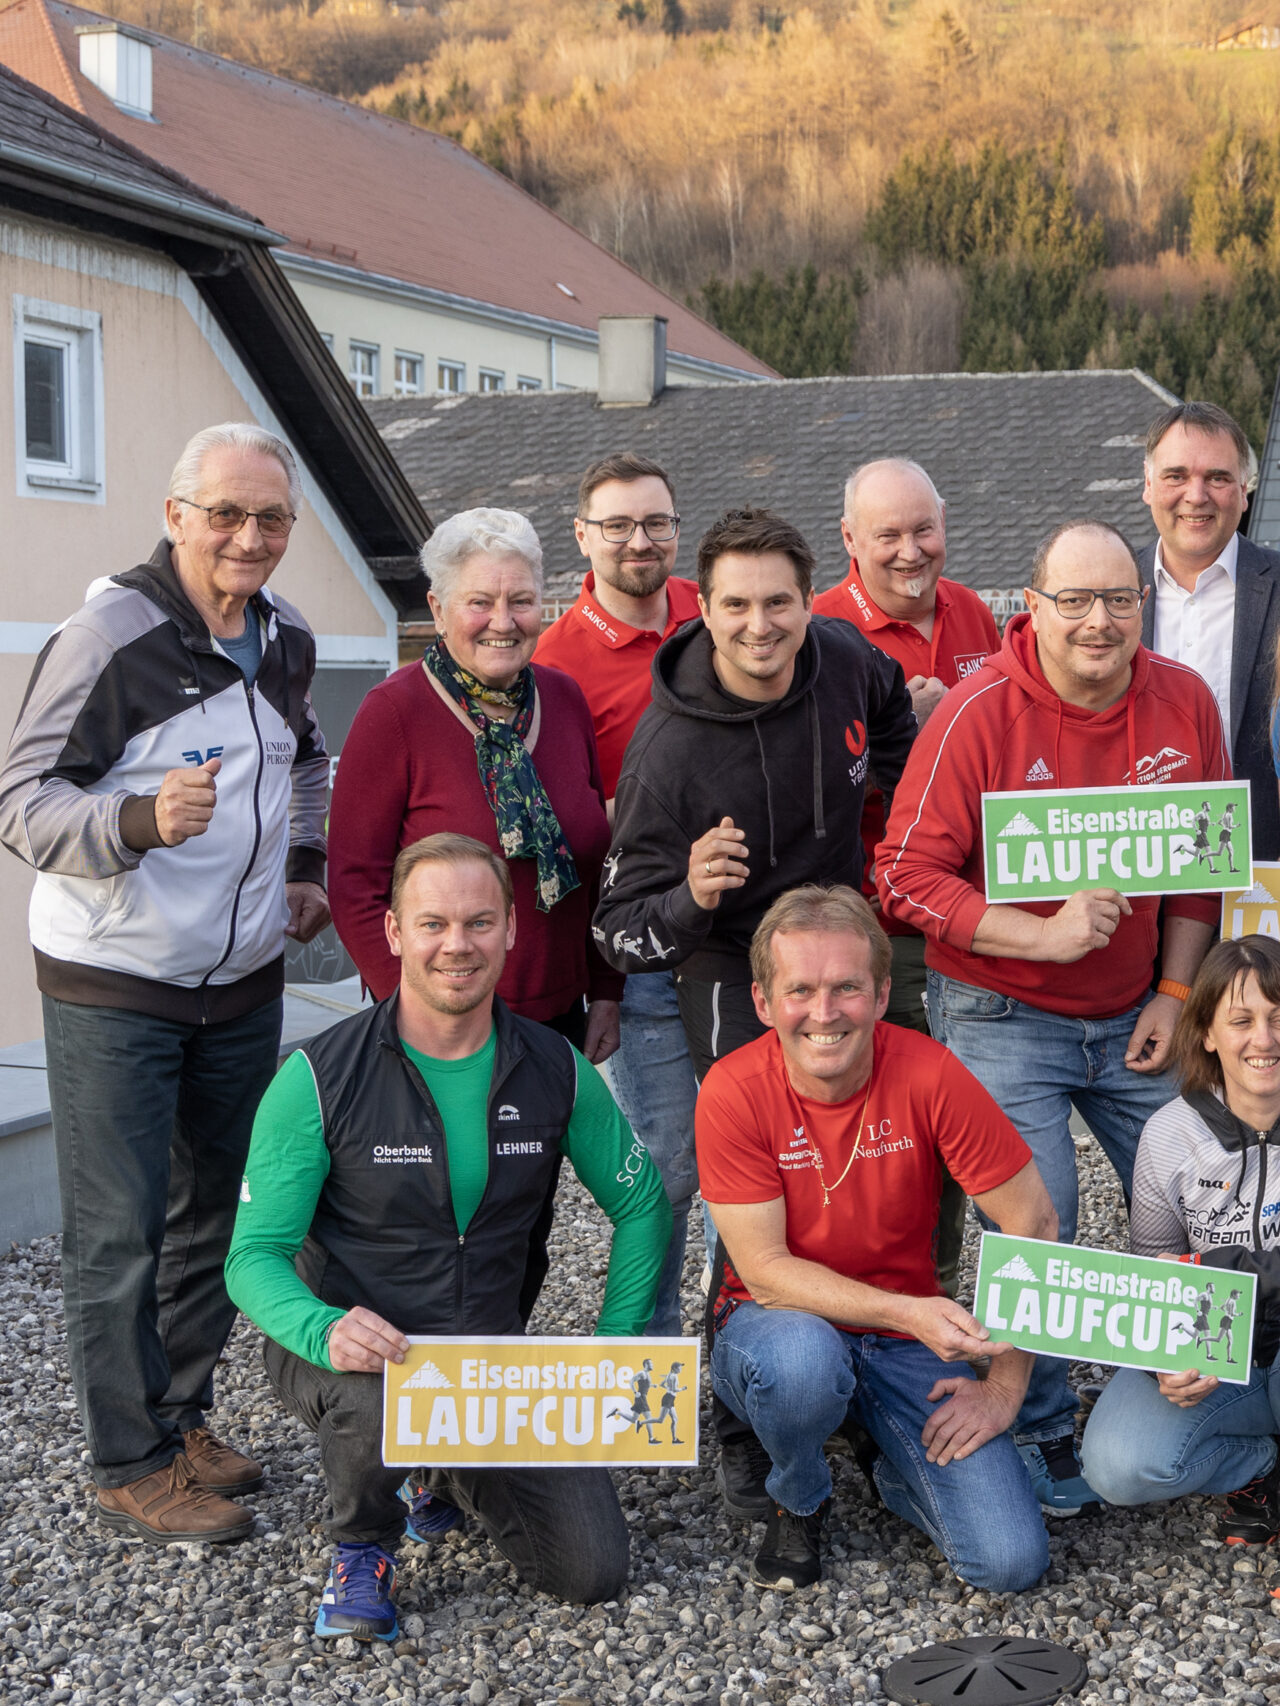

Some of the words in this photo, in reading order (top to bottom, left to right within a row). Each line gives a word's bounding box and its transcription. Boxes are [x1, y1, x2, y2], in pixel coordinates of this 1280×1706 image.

[848, 583, 867, 609] SAIKO
[581, 605, 607, 631] SAIKO
[265, 741, 291, 752] UNION
[1026, 772, 1054, 782] adidas
[1047, 803, 1195, 835] Eisenstraße
[996, 834, 1195, 885] LAUFCUP
[867, 1119, 893, 1141] LC
[373, 1145, 432, 1157] Oberbank
[404, 1156, 417, 1165] jede
[418, 1156, 433, 1164] Bank
[496, 1142, 543, 1155] LEHNER
[853, 1136, 914, 1160] Neufurth
[1045, 1257, 1199, 1308] Eisenstraße
[984, 1282, 1196, 1356] LAUFCUP
[460, 1359, 634, 1390] Eisenstraße
[396, 1396, 634, 1446] LAUFCUP
